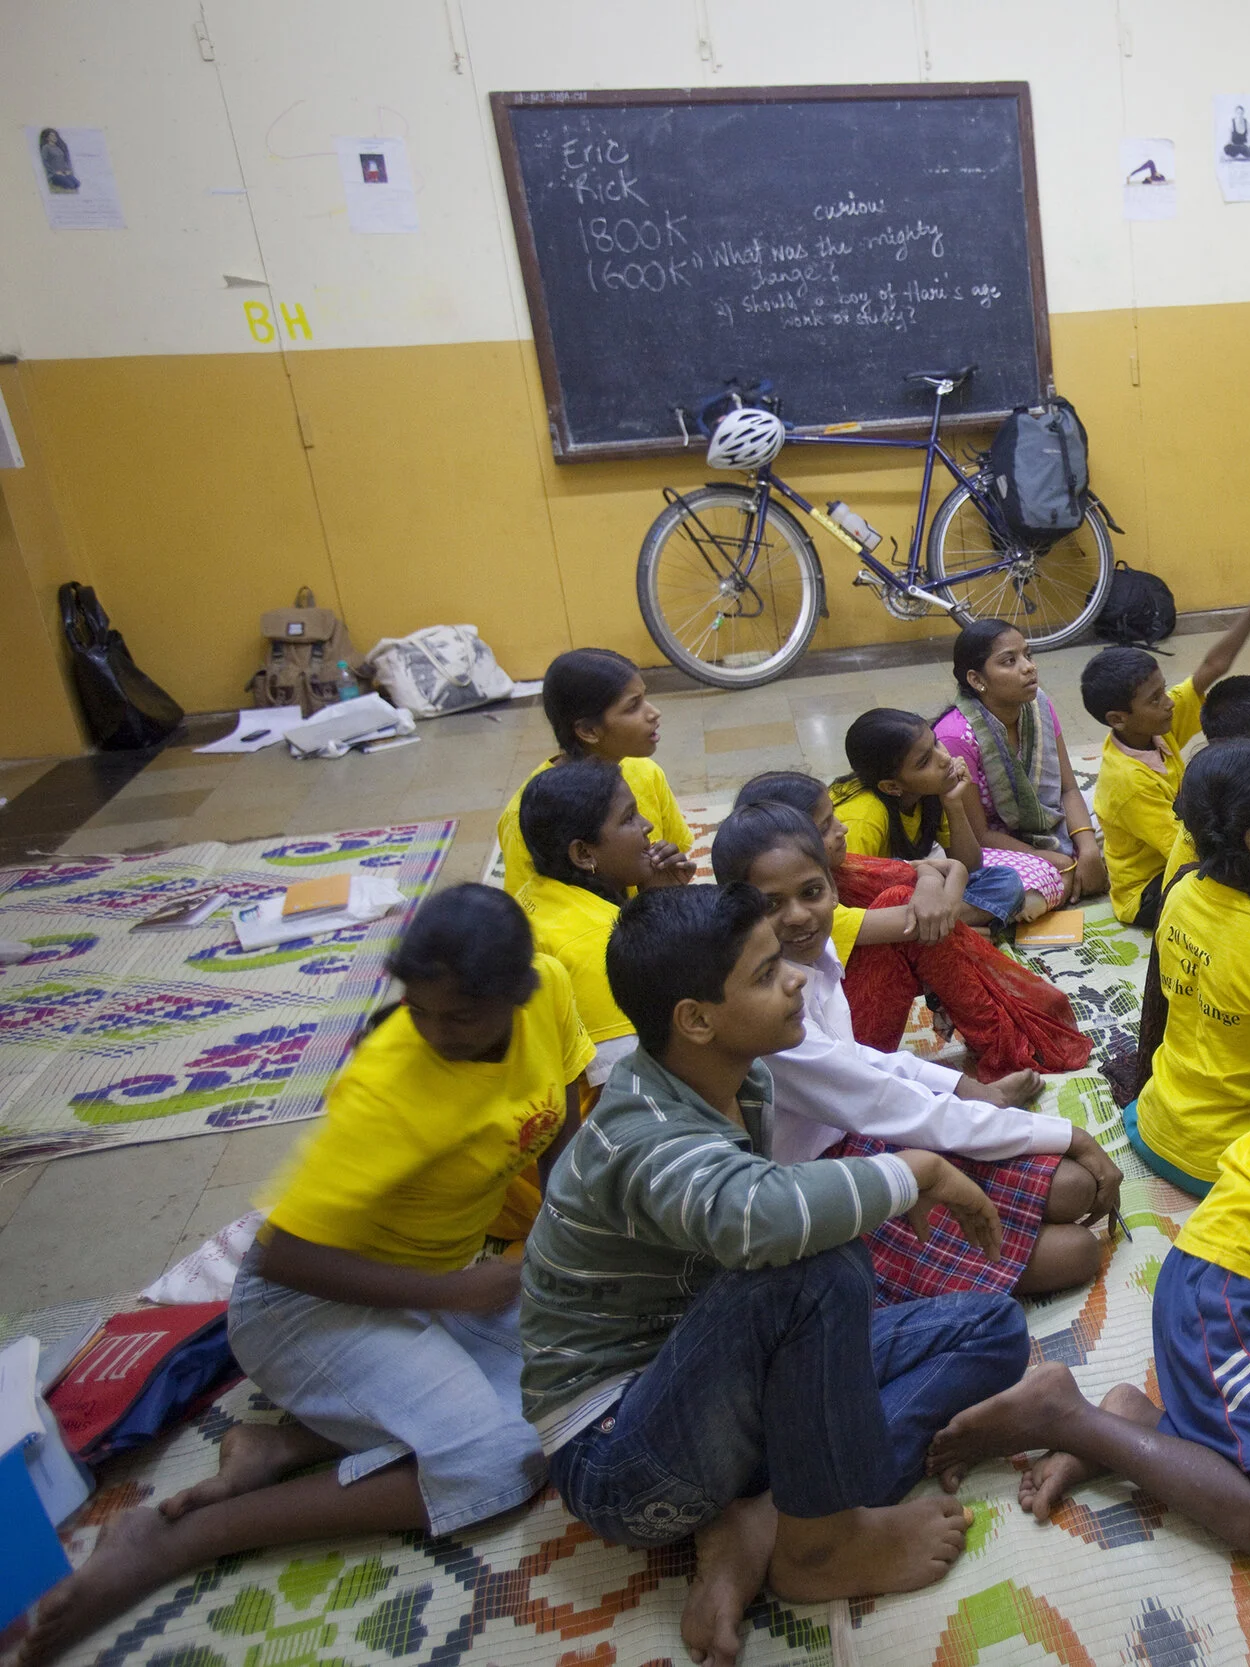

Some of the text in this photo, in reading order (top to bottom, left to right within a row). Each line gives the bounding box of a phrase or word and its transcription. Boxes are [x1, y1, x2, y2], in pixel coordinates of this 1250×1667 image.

[562, 138, 630, 170] Eric
[576, 168, 650, 208] Rick
[578, 210, 689, 254] 1800K
[708, 238, 764, 267] What
[771, 243, 808, 262] was
[816, 235, 853, 257] the
[865, 220, 944, 261] mighty
[971, 283, 1001, 309] age
[1167, 925, 1213, 967] 20 Years
